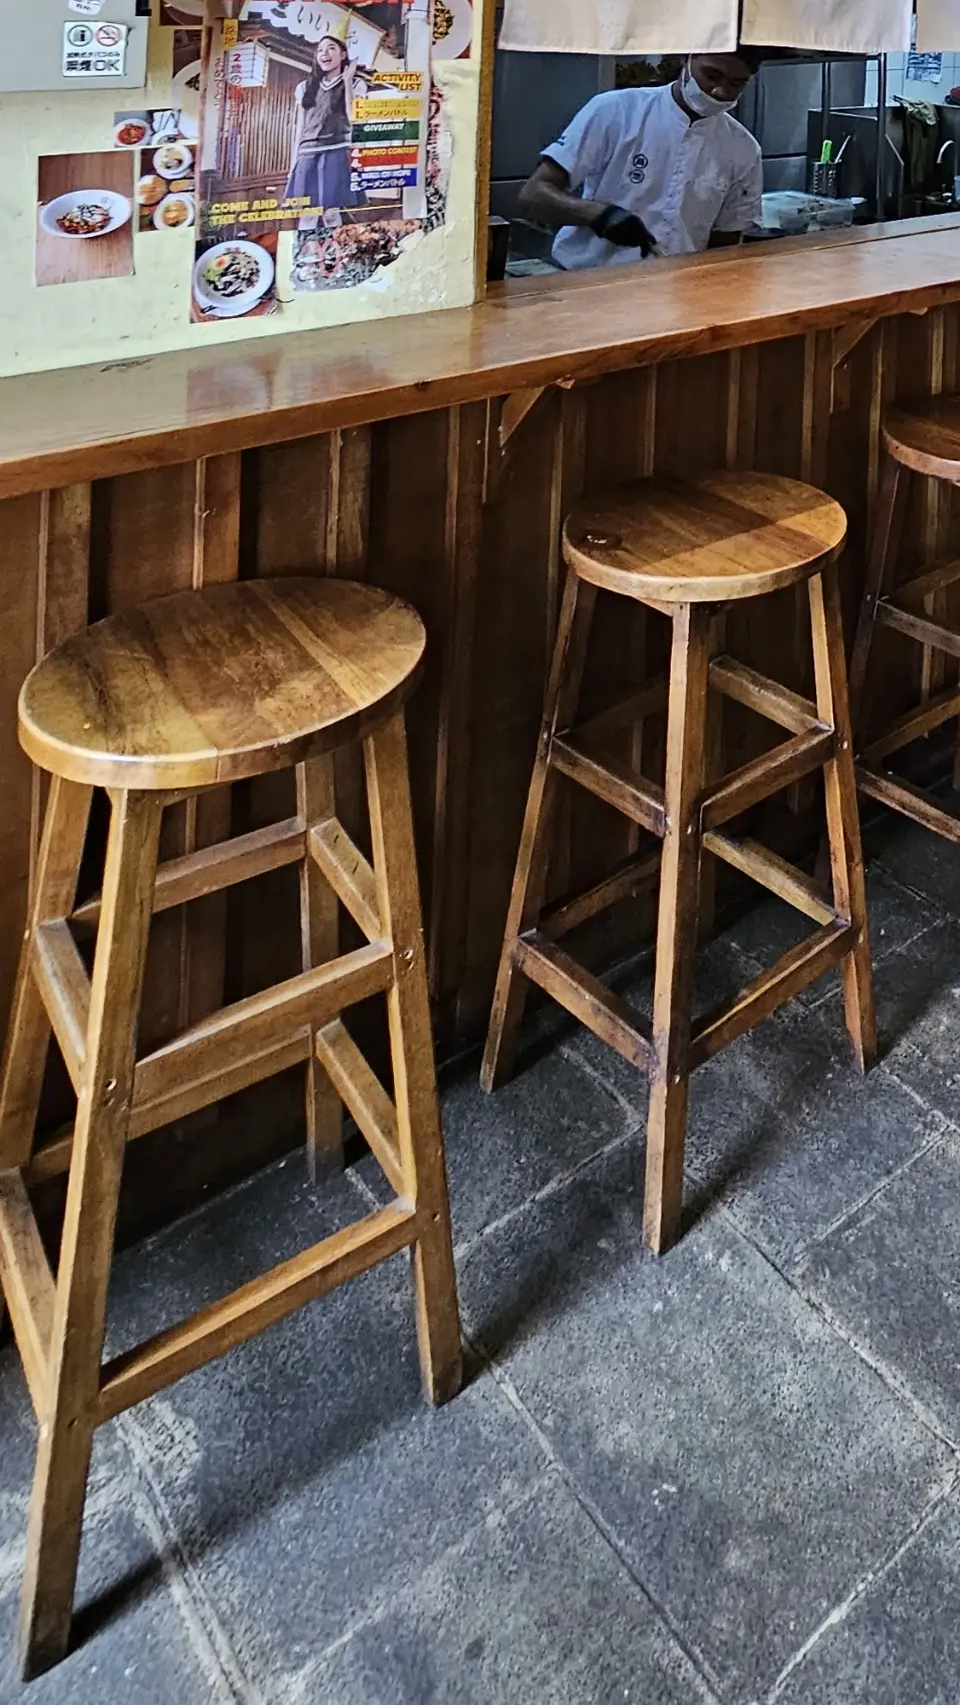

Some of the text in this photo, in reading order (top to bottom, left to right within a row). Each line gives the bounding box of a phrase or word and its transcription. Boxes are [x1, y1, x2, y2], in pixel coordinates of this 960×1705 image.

[374, 73, 422, 83] ACTIVITY
[400, 83, 422, 91] LIST
[363, 123, 405, 132] GIVEAWAY
[211, 201, 249, 214] COME
[252, 199, 278, 210] AND
